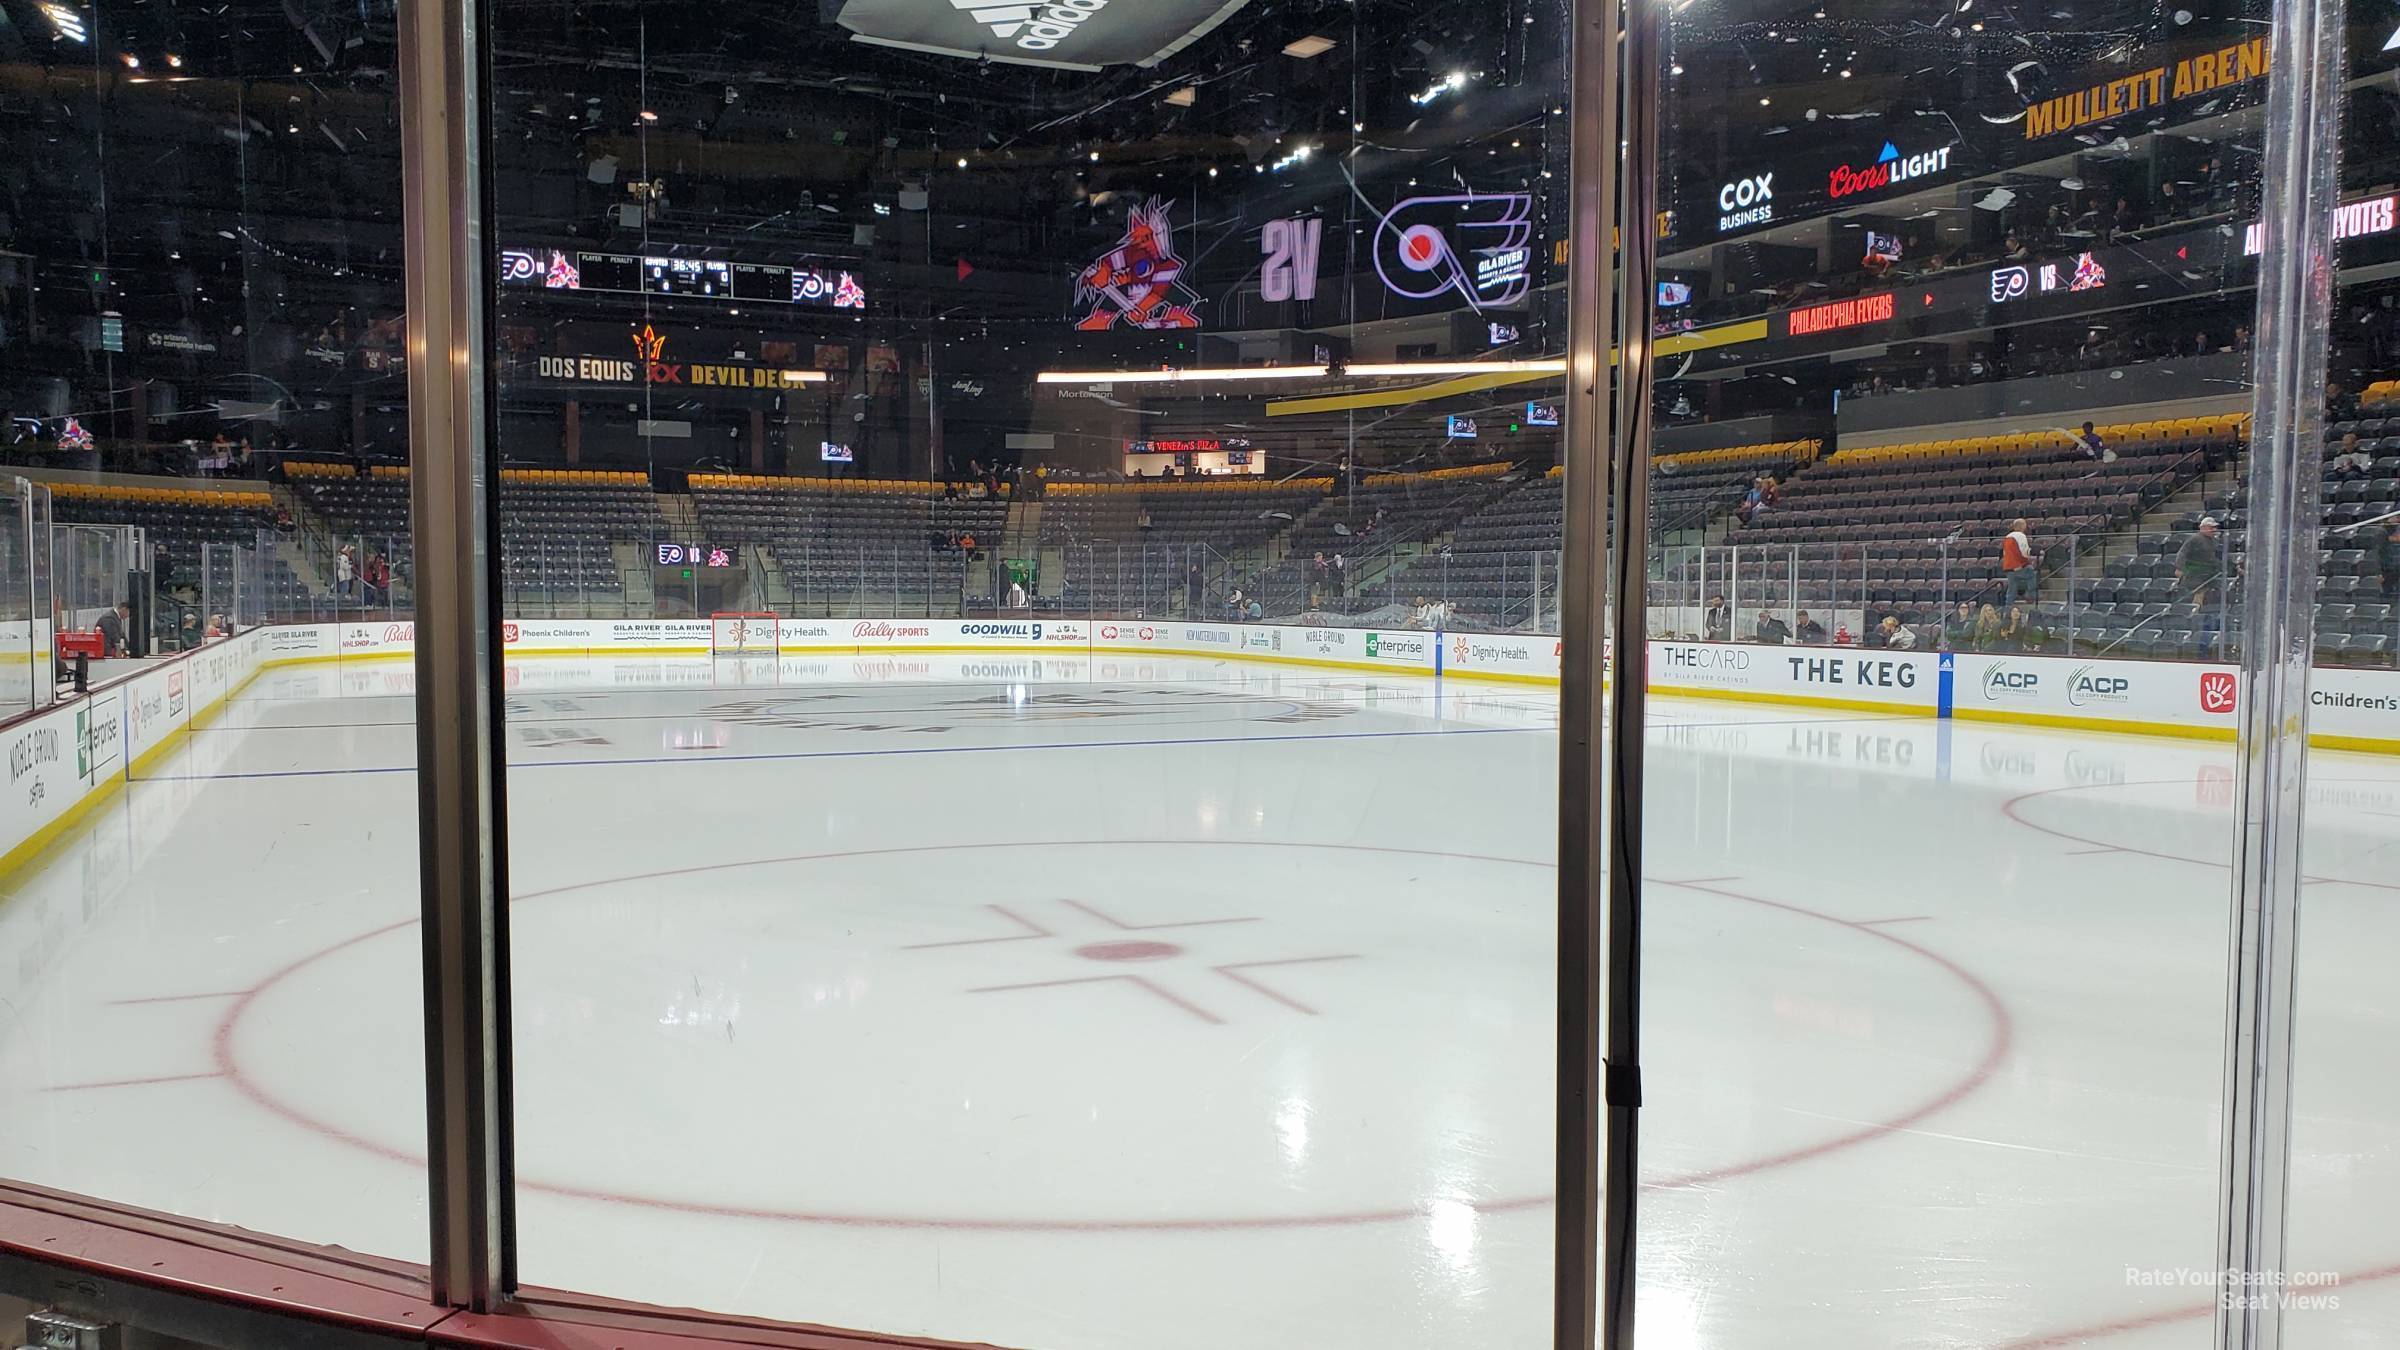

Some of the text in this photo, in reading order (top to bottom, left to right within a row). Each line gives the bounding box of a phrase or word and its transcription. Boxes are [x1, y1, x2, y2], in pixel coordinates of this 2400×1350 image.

[1017, 0, 1109, 50] adida
[2026, 67, 2166, 140] MULLETT
[1830, 147, 1950, 198] Coors LIGHT
[1719, 172, 1773, 211] COX
[1719, 205, 1772, 231] BUSINESS
[673, 259, 701, 272] 36:45
[1478, 250, 1523, 273] GILA RIVER
[654, 266, 662, 278] 0
[721, 271, 728, 282] 0
[2040, 264, 2057, 291] VS
[1789, 294, 1893, 336] PHILADELPHIA FLYERS
[539, 356, 575, 377] DOS
[580, 358, 634, 381] EQUIS
[691, 364, 750, 388] DEVIL
[1058, 389, 1114, 399] Mortenson
[521, 629, 590, 637] Phoenix Children's
[755, 627, 792, 639] Dignity
[852, 621, 929, 641] Bally SPORTS
[960, 624, 1028, 635] GOODWILL
[1306, 630, 1344, 645] NOBLE GROUND
[1367, 640, 1422, 655] enterprise
[1472, 645, 1501, 661] Dignity
[1788, 657, 1916, 688] THE KEG
[1991, 672, 2038, 688] ACP
[2076, 677, 2129, 694] ACP
[2311, 691, 2397, 710] Children's
[9, 728, 59, 786] NOBLE GROUND
